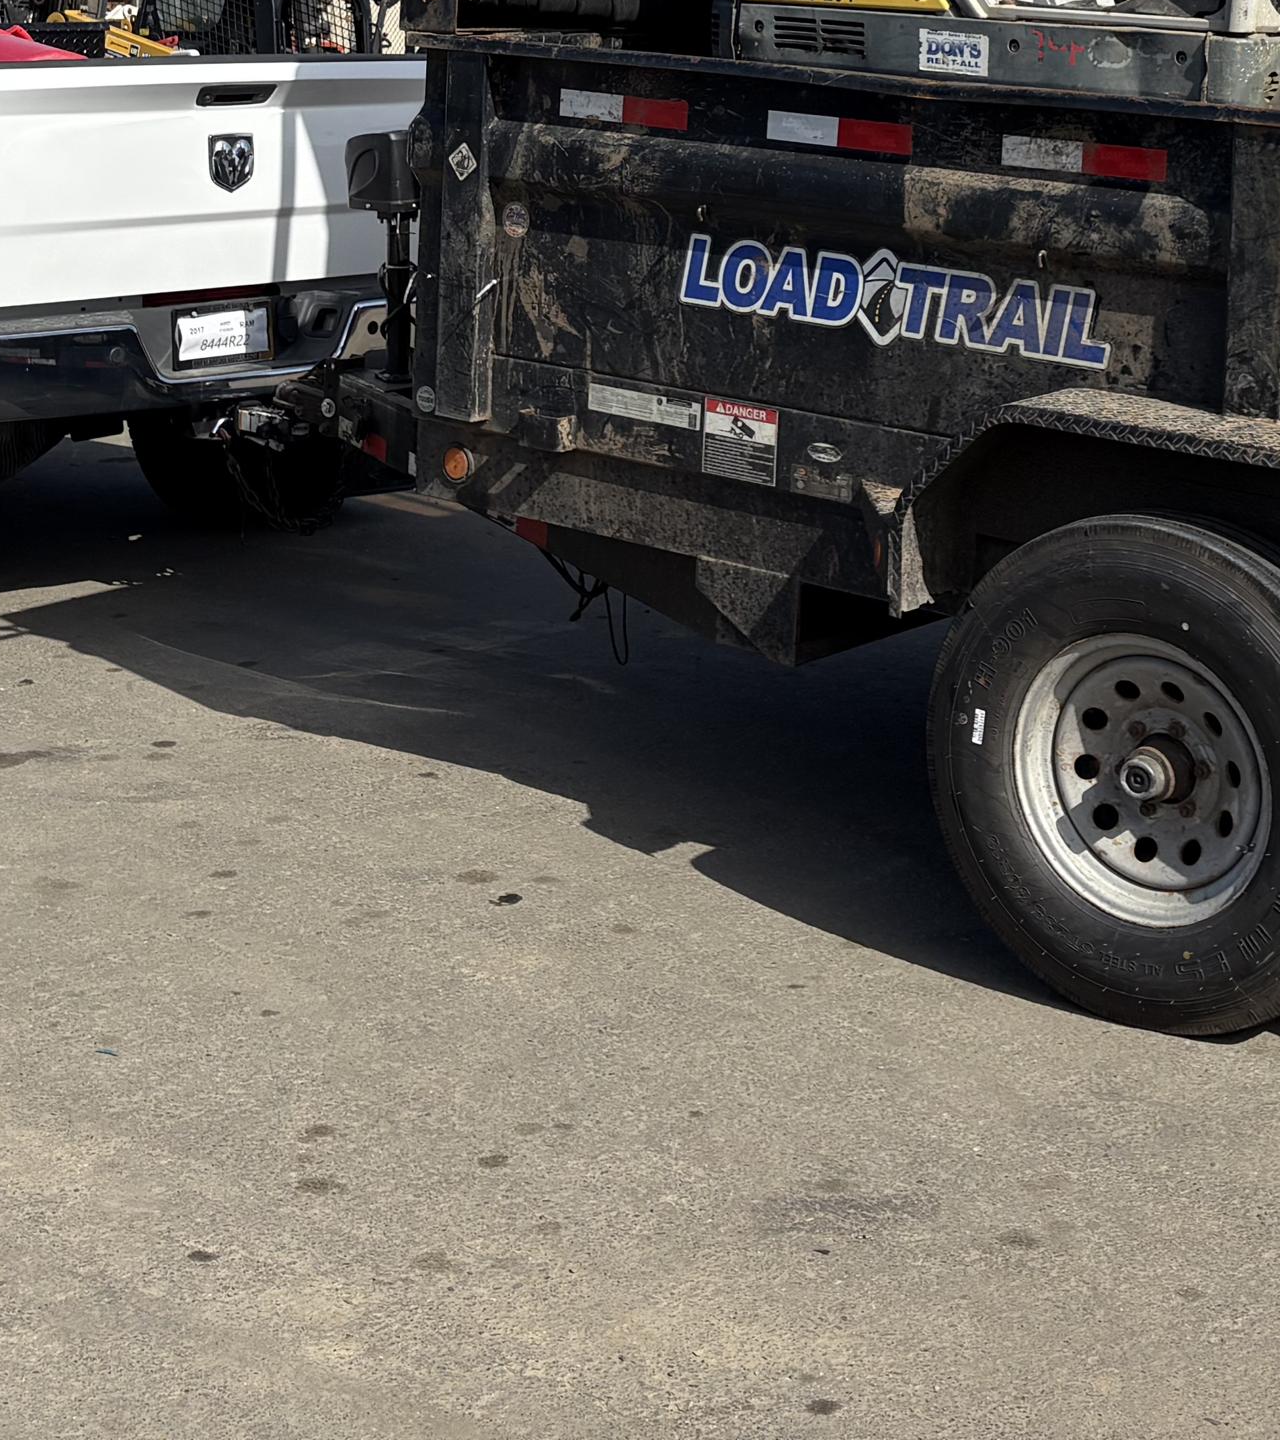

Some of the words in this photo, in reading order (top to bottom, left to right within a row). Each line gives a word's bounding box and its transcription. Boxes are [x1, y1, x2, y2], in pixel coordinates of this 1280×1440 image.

[926, 37, 982, 60] DON'S
[678, 233, 866, 328] LOAD
[895, 261, 1112, 370] TRAIL
[200, 334, 251, 352] 8444R22
[725, 403, 767, 422] DANGER
